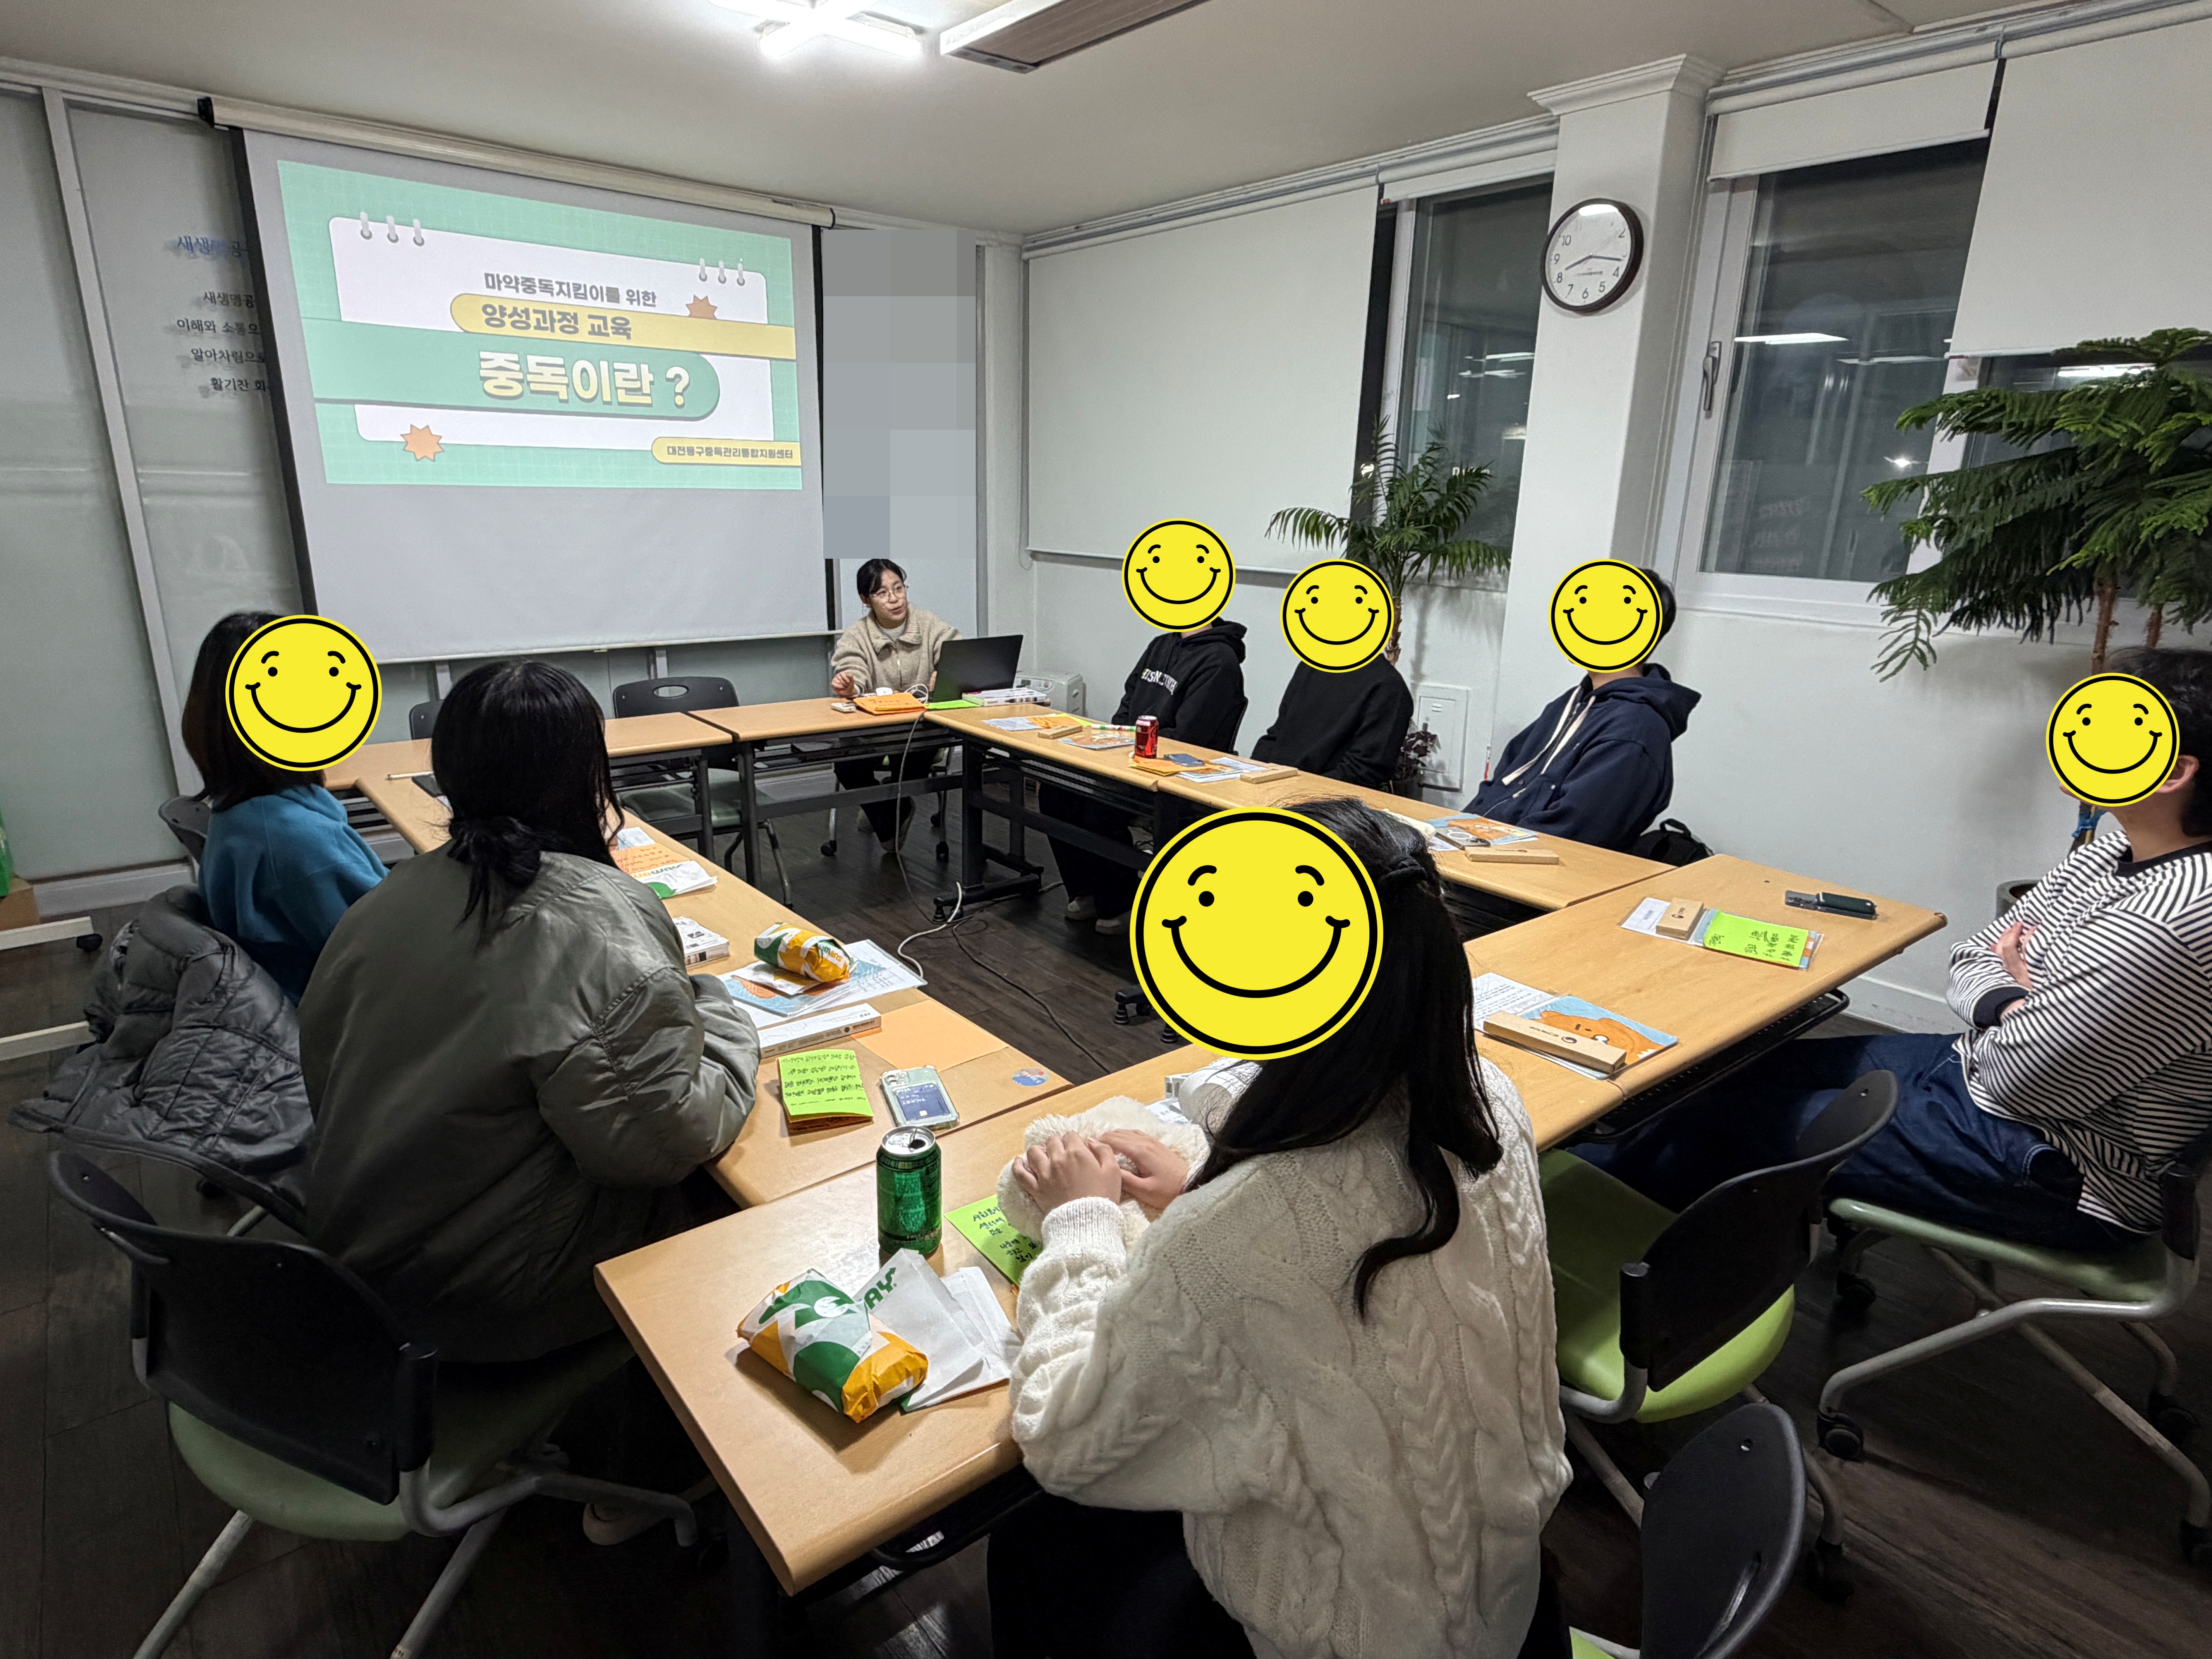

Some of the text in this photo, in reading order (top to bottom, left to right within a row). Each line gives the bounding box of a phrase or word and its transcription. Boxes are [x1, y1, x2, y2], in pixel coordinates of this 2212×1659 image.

[1561, 235, 1572, 246] 10
[1554, 253, 1560, 264] 9
[1556, 272, 1563, 283] 8
[1612, 266, 1620, 278] 4
[484, 273, 657, 307] 마약중독지킴이를 위한
[1566, 284, 1573, 296] 7
[1598, 281, 1606, 293] 5
[1582, 288, 1589, 299] 6
[177, 318, 217, 334] 이해와
[482, 304, 632, 340] 양성과정 교육
[479, 351, 690, 409] 중독이란 ?
[667, 446, 793, 459] 대전동구중독관리통합지원센터
